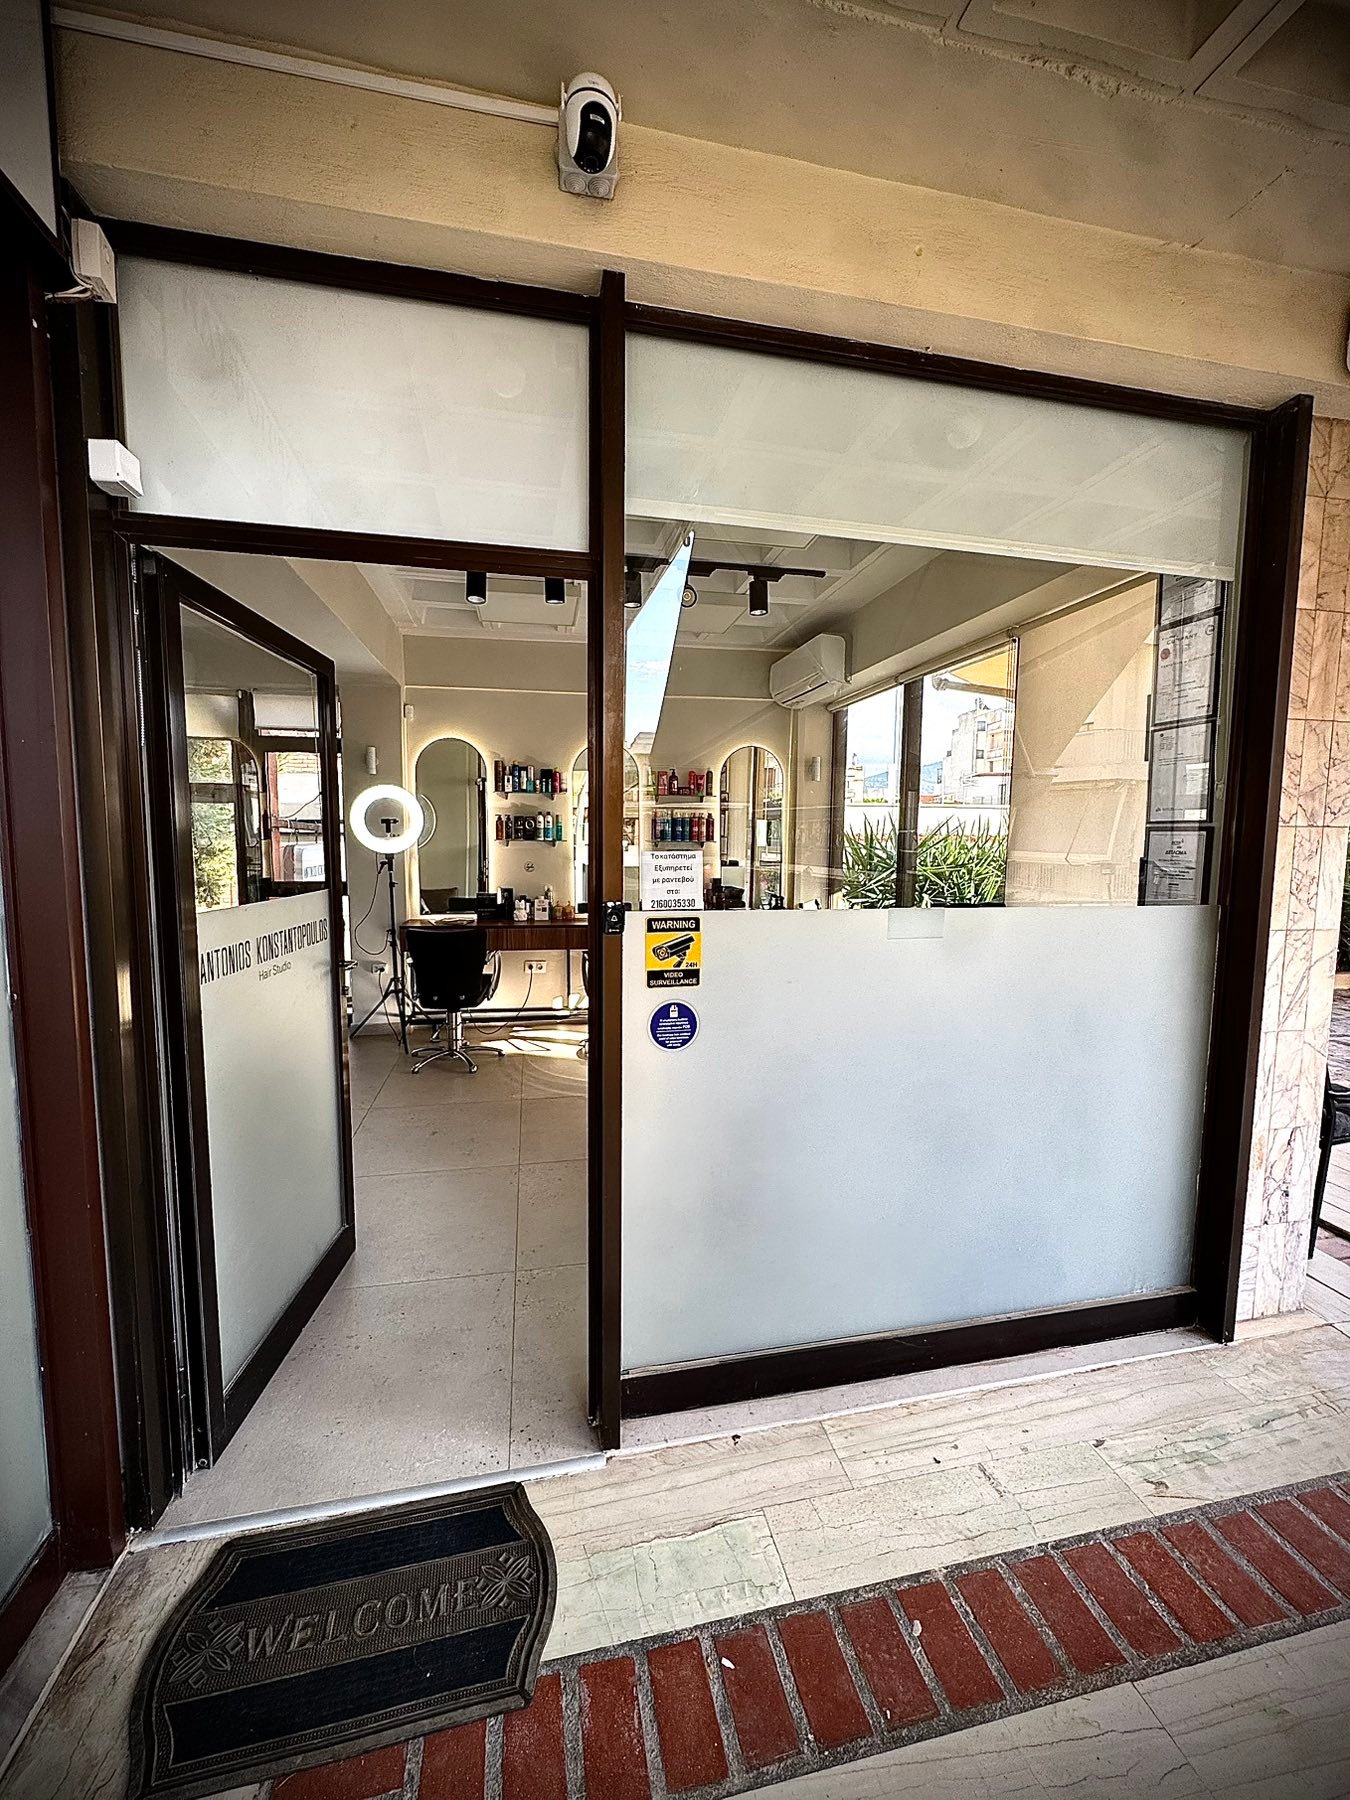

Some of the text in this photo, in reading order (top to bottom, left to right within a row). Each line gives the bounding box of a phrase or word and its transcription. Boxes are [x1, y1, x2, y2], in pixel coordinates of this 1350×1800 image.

[662, 876, 694, 884] ραντεβού
[651, 899, 696, 908] 2160035330
[651, 920, 696, 929] WARNING
[200, 918, 328, 985] ANTONIOS KONSTANTOPOULOS
[259, 961, 291, 981] Hair Studio
[650, 978, 698, 986] SURVEILLANCE
[245, 1576, 481, 1662] WELCOME
